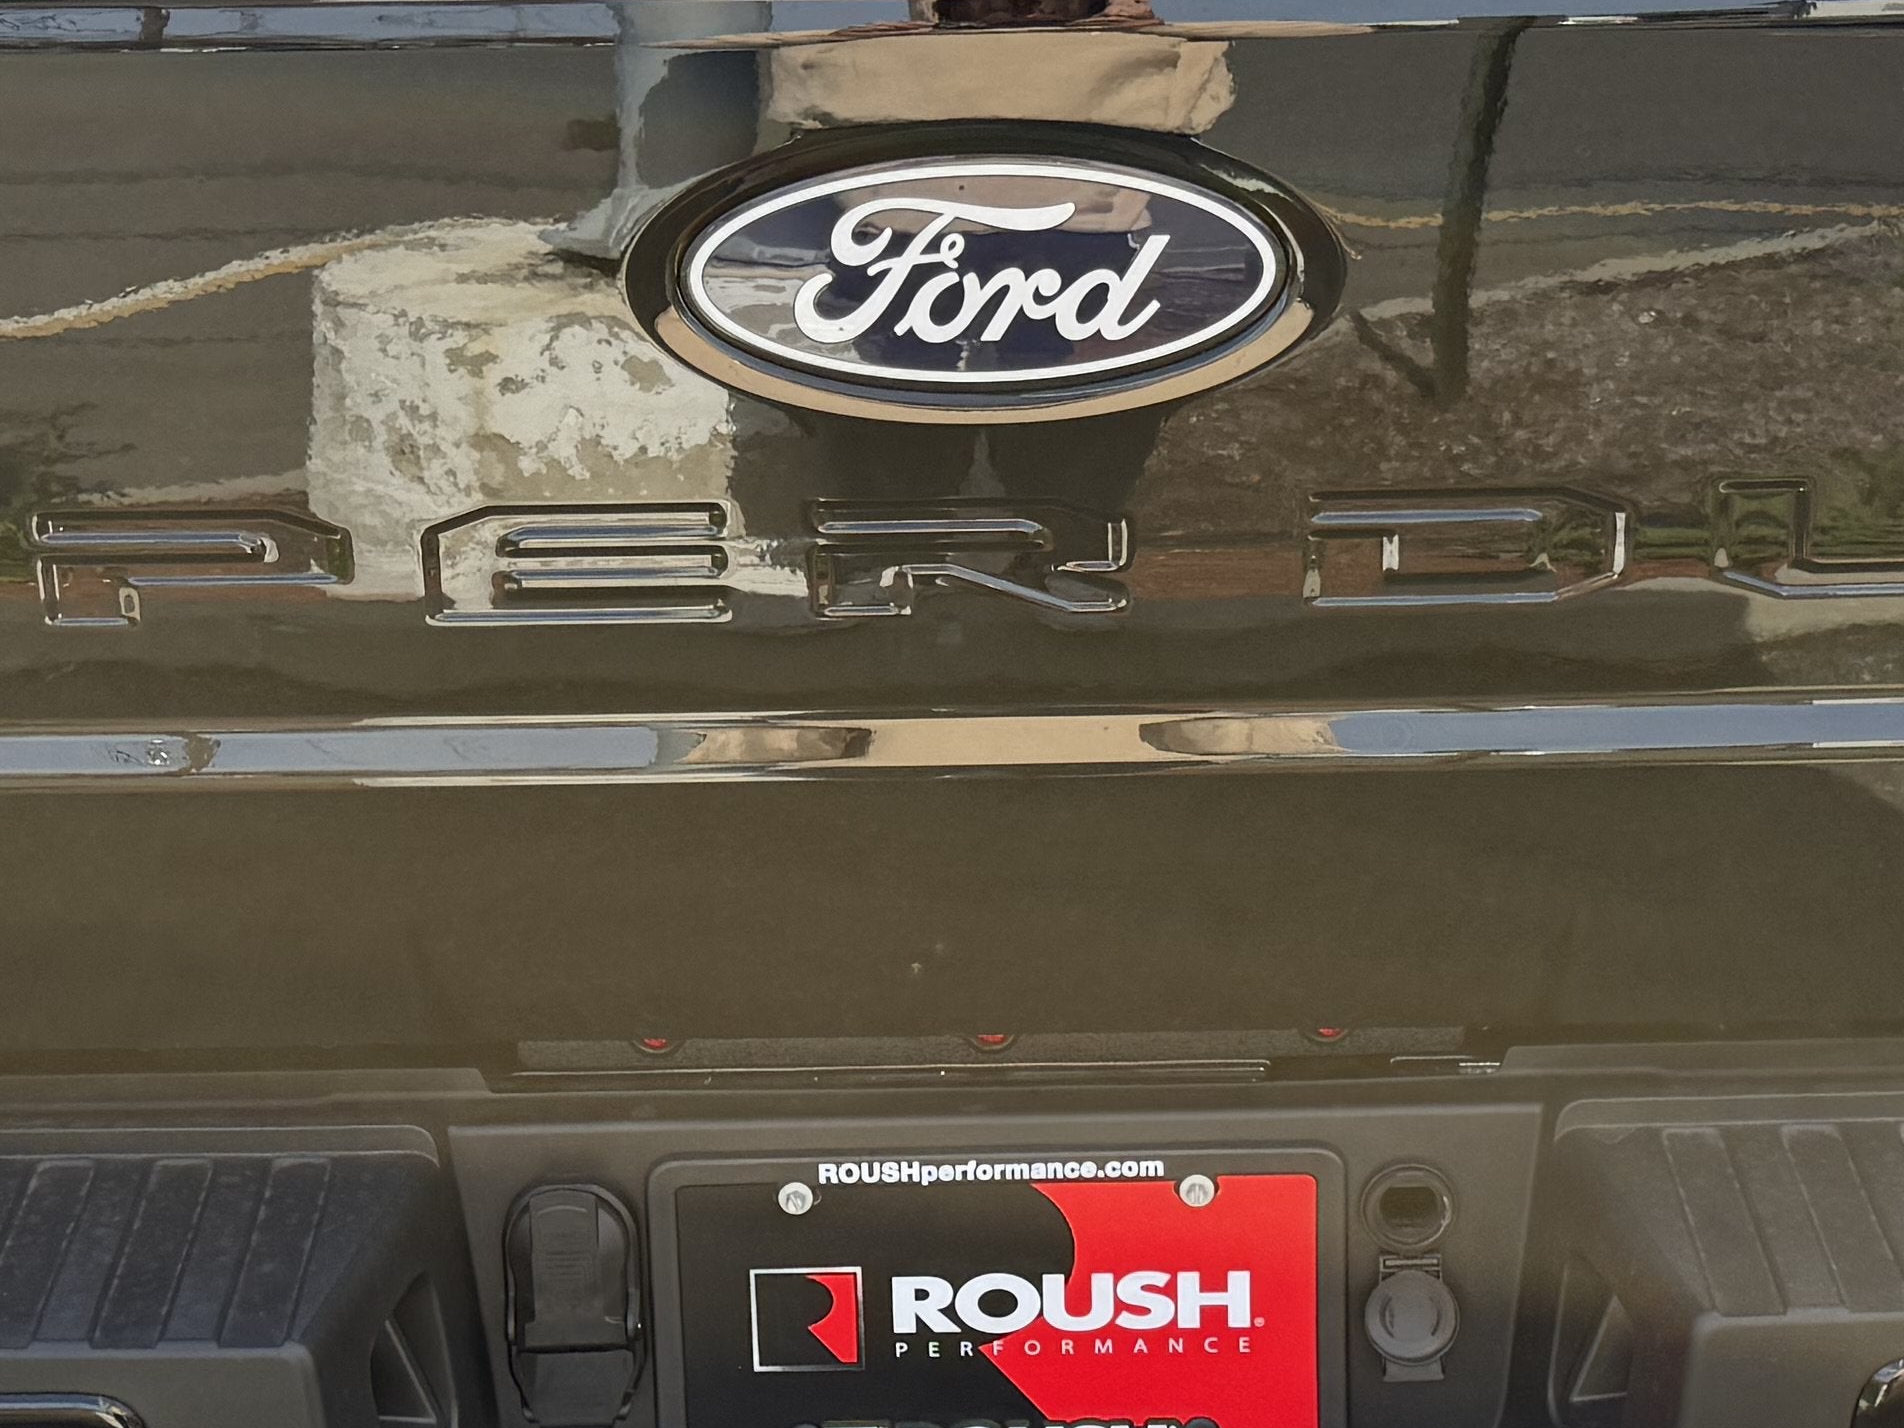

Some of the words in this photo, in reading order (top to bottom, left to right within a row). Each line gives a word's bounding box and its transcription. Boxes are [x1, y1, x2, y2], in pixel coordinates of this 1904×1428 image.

[793, 197, 1172, 344] Ford
[817, 1159, 1165, 1186] ROUSHperformance.com
[891, 1270, 1252, 1334] ROUSH
[895, 1336, 1253, 1359] PERFORMANCE
